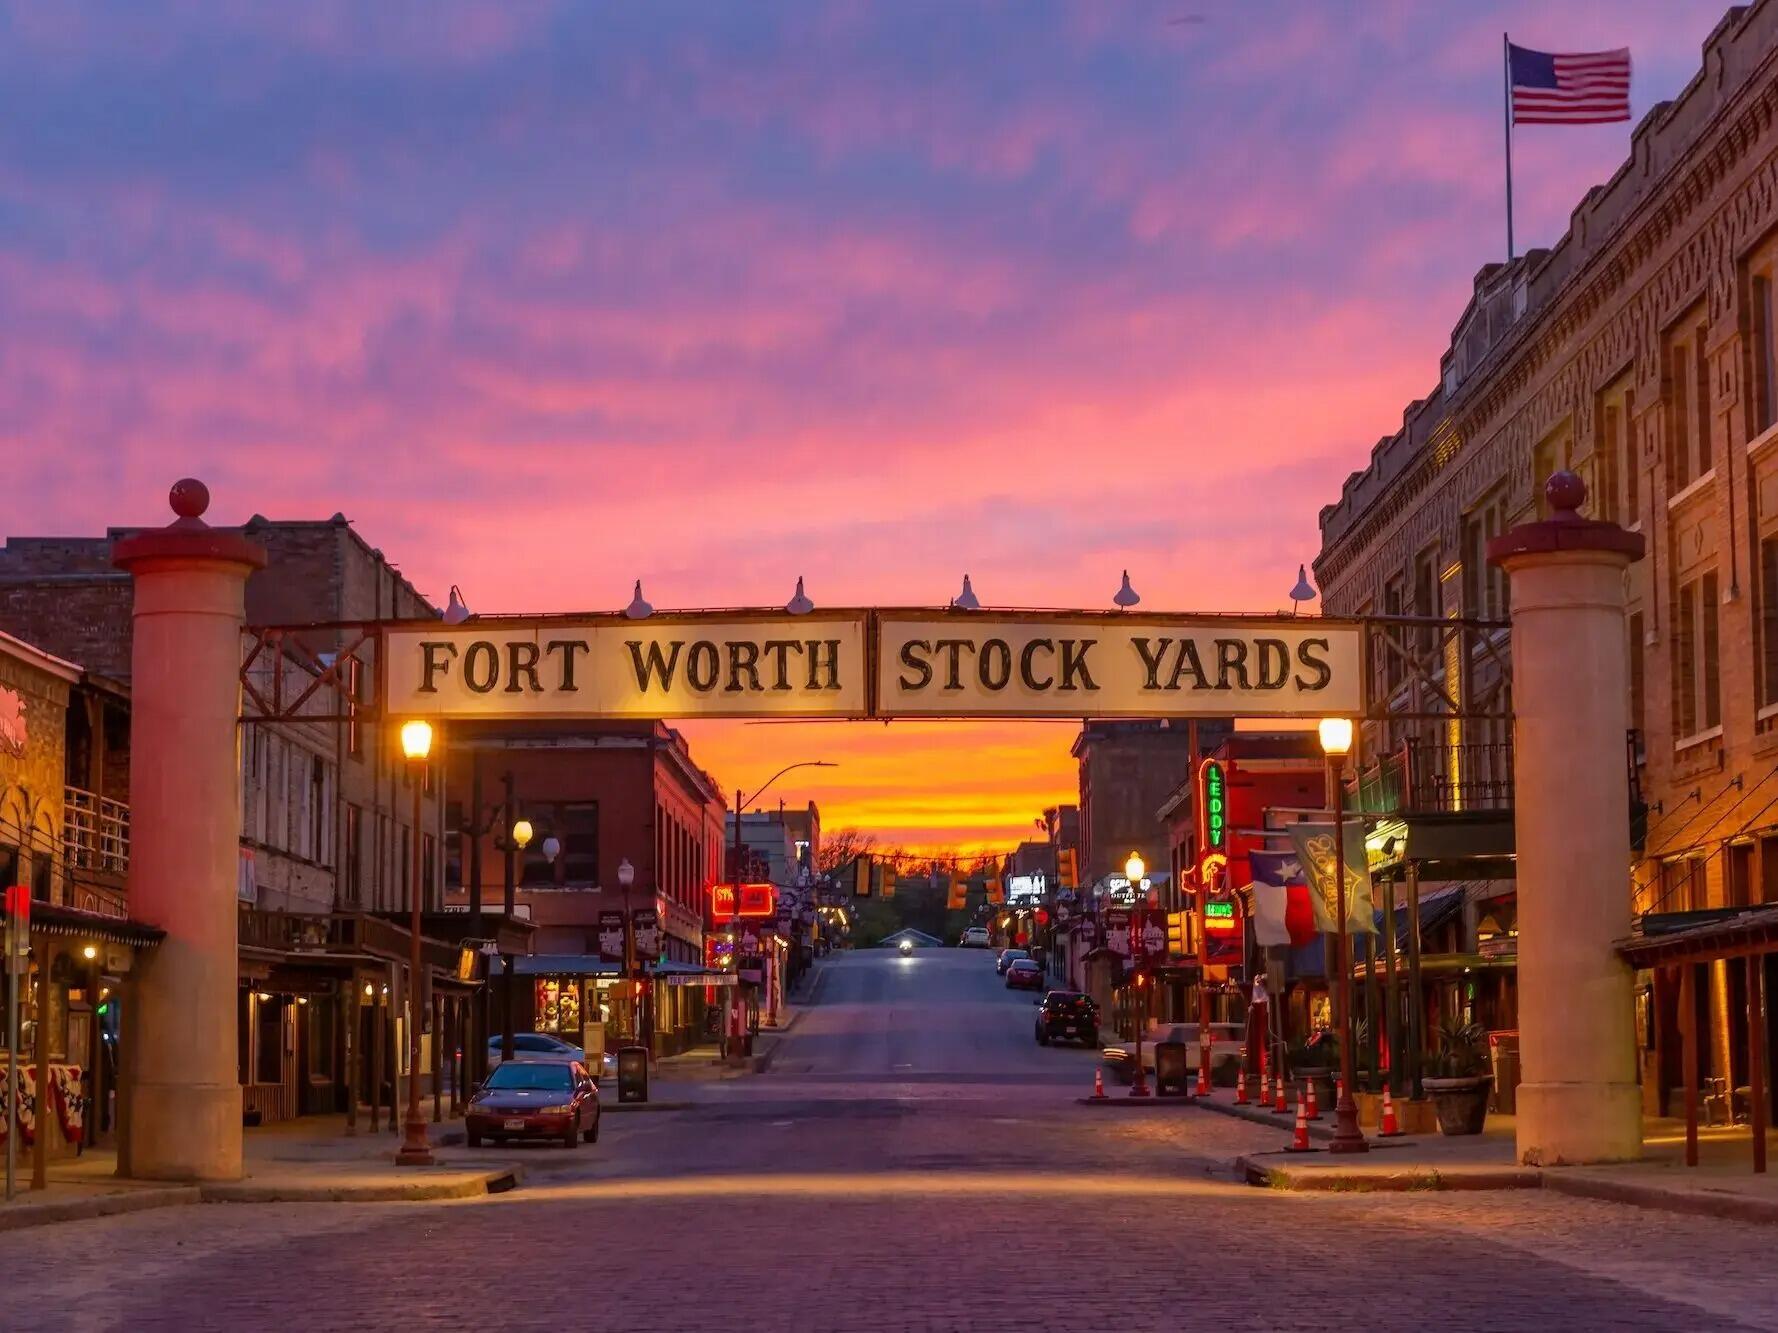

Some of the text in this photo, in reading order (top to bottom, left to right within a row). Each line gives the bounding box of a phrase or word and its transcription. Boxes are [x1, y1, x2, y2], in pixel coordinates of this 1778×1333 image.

[418, 636, 1333, 693] FORT WORTH STOCK YARDS
[1208, 766, 1223, 846] LEDDY
